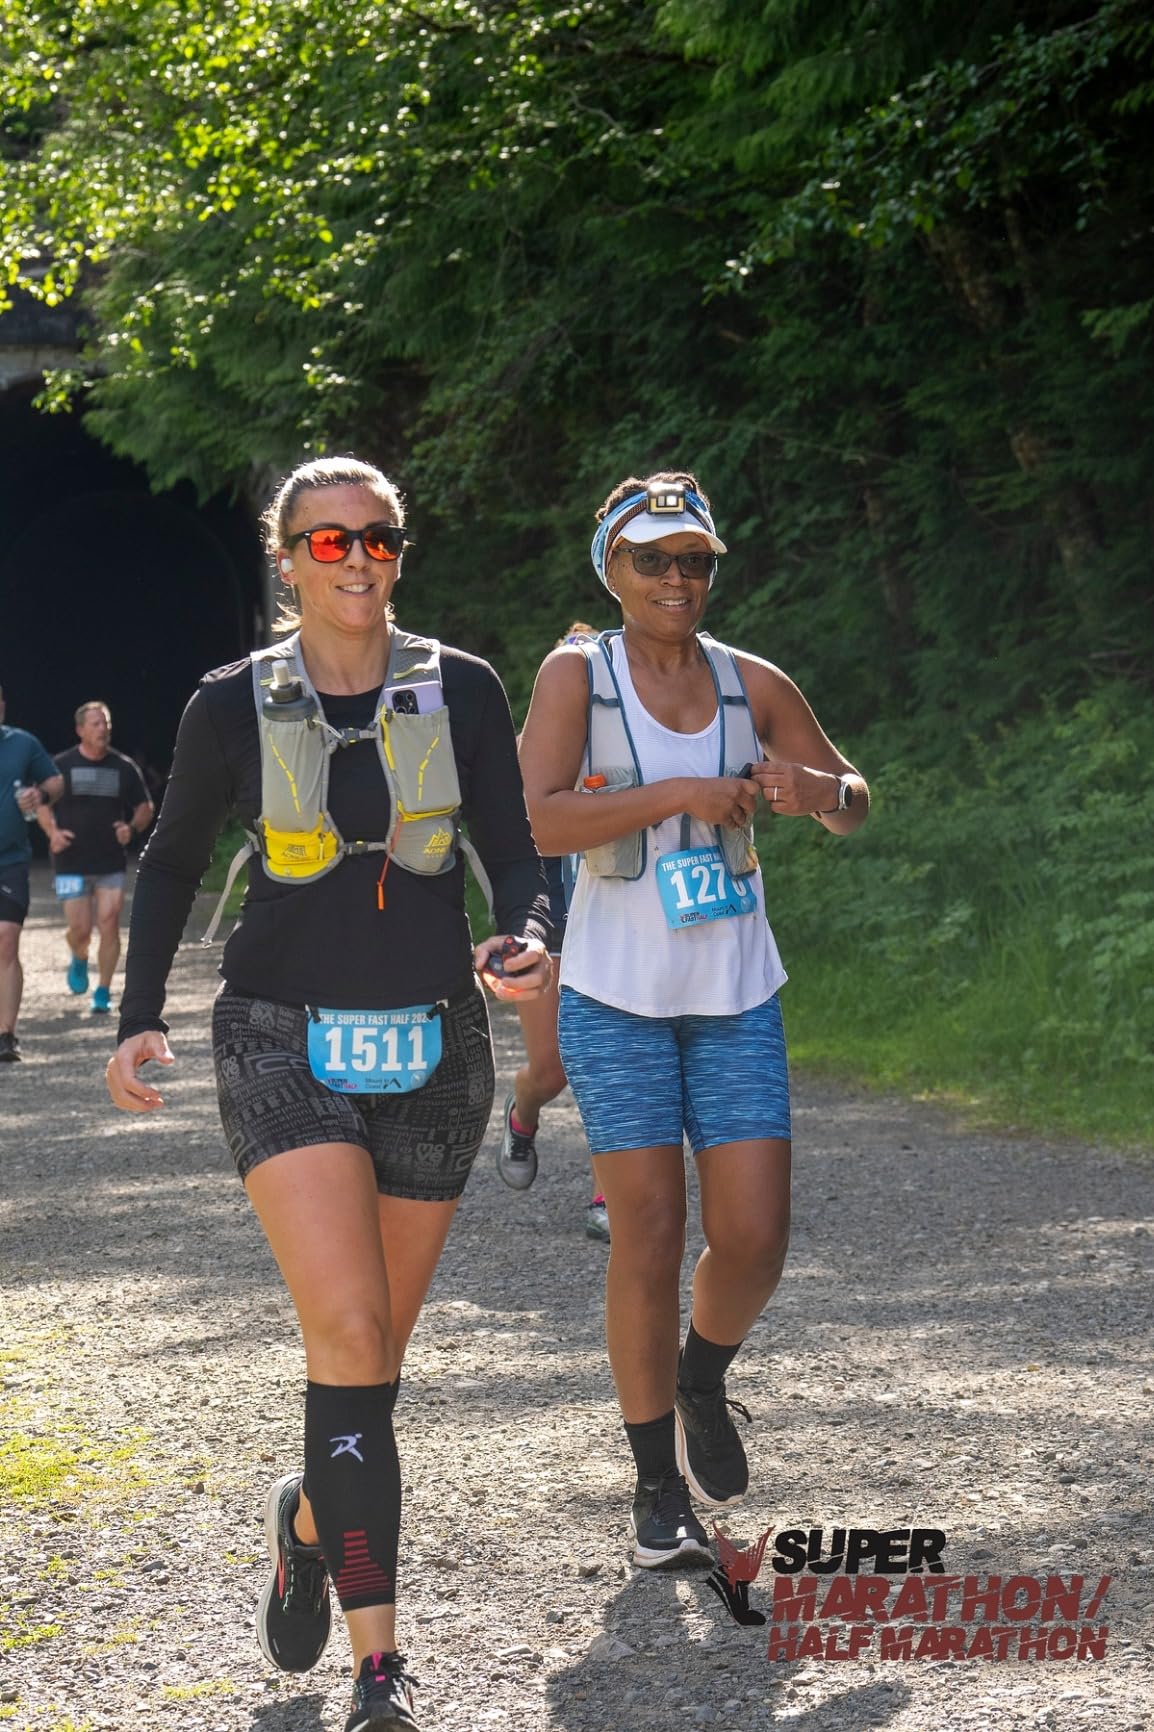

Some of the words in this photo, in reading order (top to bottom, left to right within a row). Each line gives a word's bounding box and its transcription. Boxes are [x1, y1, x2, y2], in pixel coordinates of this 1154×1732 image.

[662, 862, 677, 872] THE
[678, 856, 699, 869] SUPER
[699, 853, 713, 864] FAST
[319, 1014, 335, 1025] THE
[337, 1014, 365, 1025] SUPER
[368, 1014, 389, 1025] FAST
[390, 1013, 410, 1025] HALF
[411, 1013, 433, 1024] 202
[325, 1026, 428, 1072] 1511
